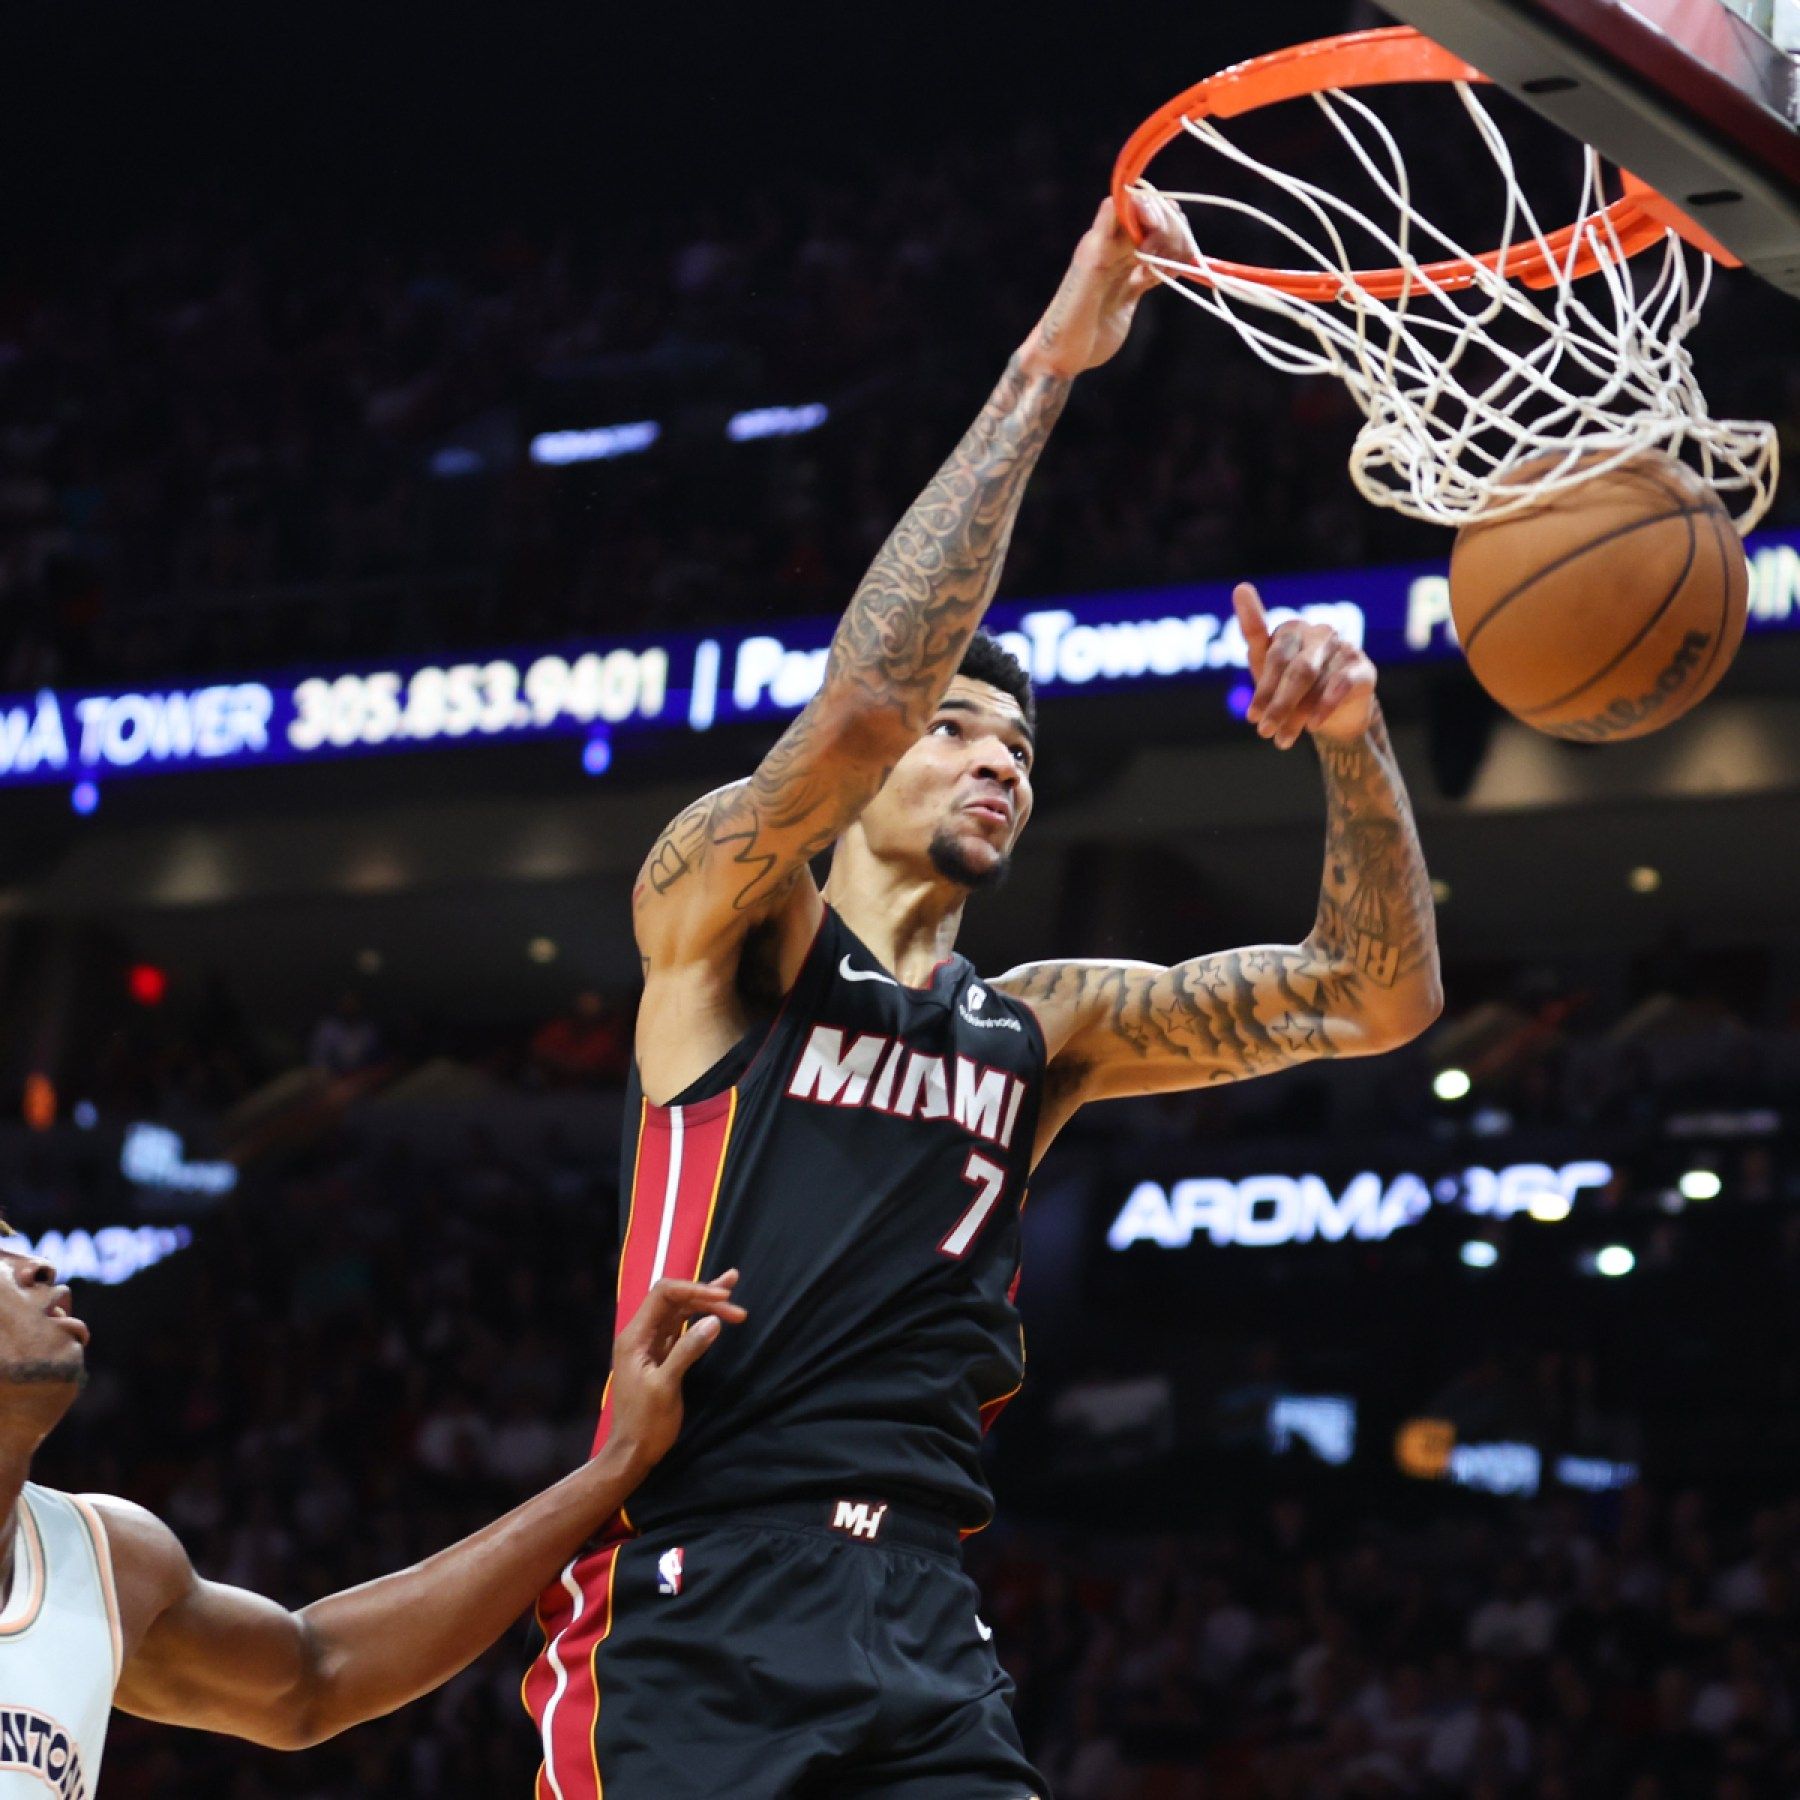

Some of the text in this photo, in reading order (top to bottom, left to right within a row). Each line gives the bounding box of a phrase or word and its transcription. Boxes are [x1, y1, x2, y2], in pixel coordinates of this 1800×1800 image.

[76, 683, 274, 767] TOWER
[787, 1024, 1027, 1150] MIAMI
[938, 1150, 1006, 1258] 7
